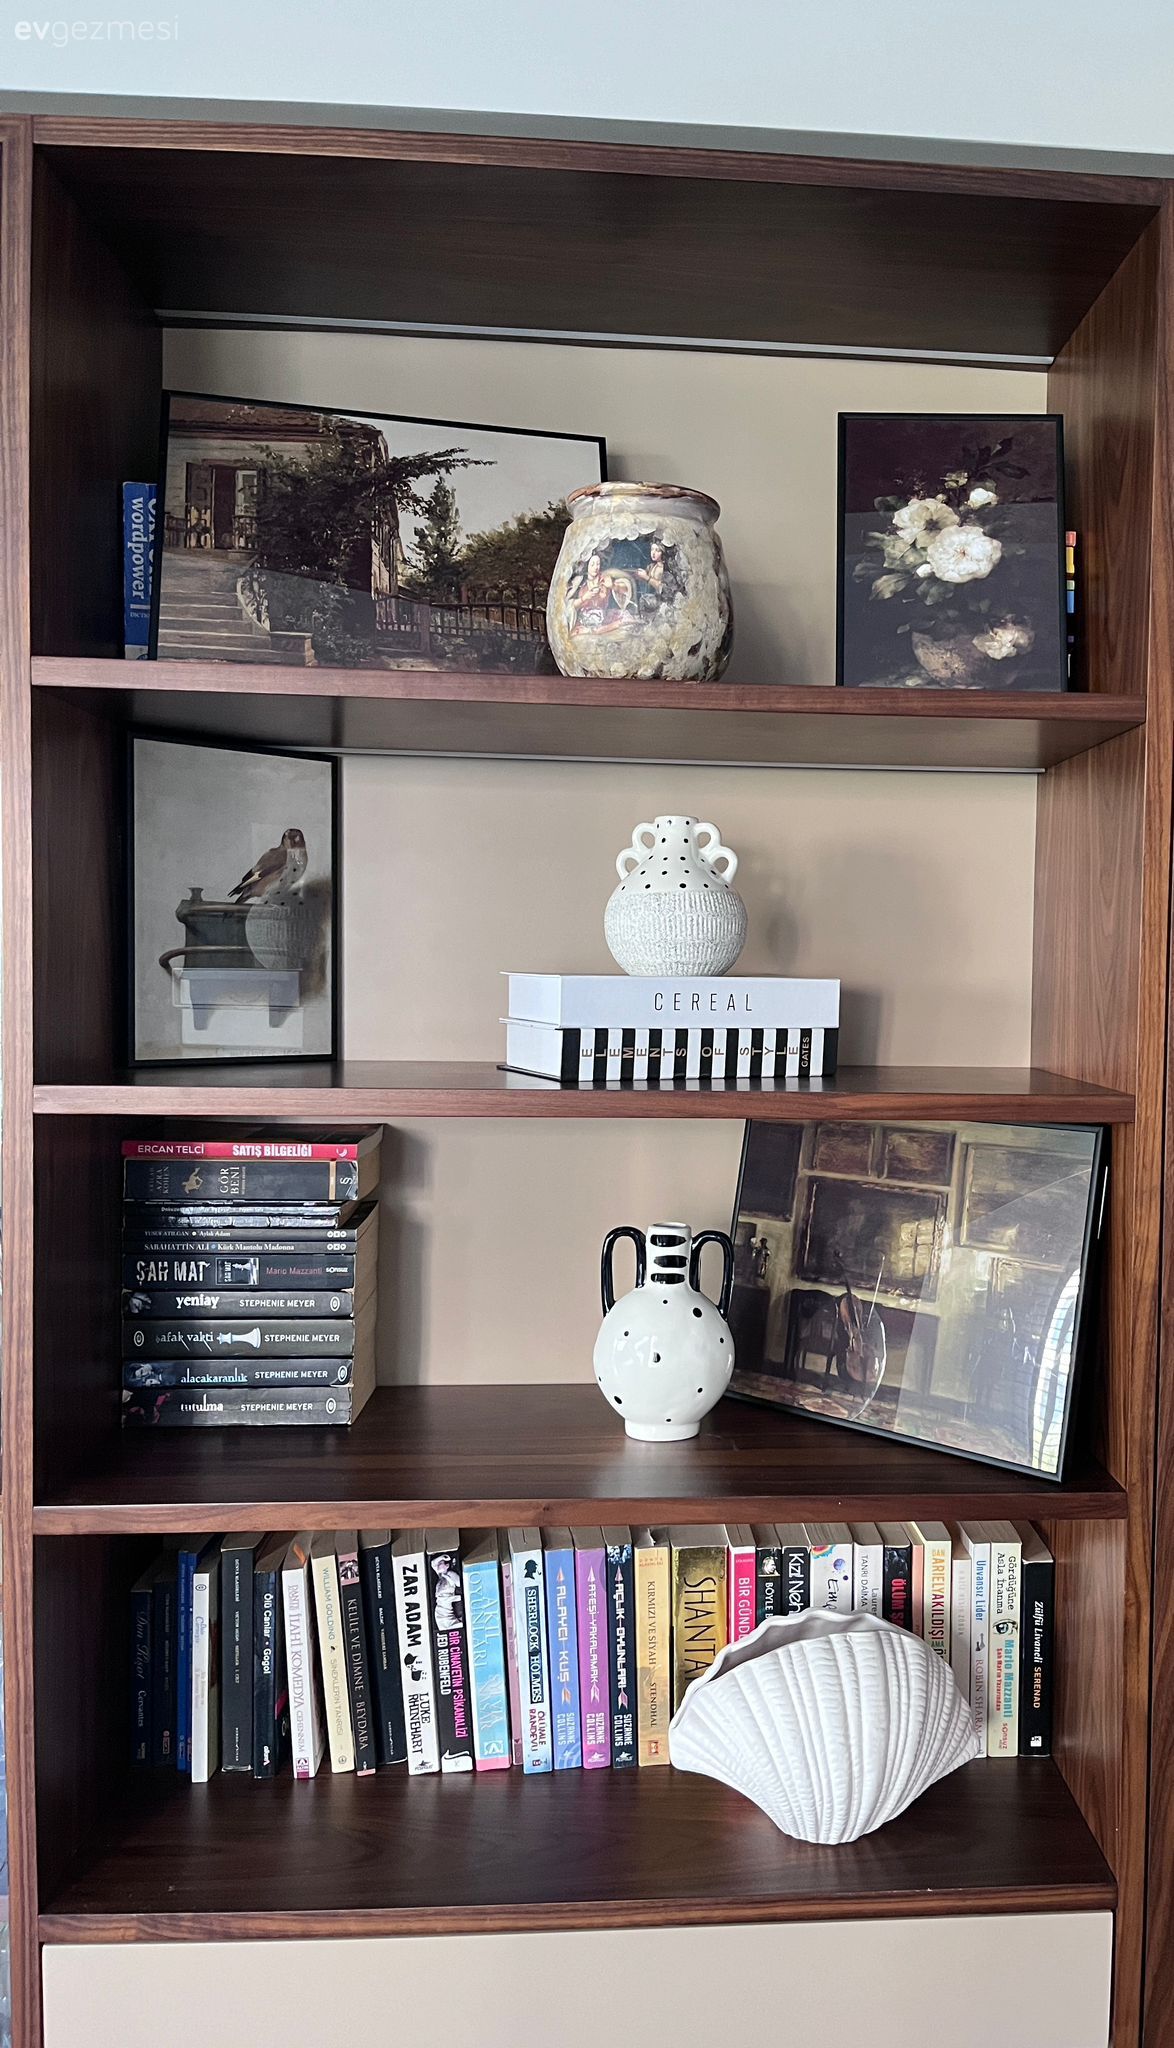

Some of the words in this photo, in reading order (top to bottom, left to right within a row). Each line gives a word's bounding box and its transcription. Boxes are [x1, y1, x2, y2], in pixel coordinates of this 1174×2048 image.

[127, 497, 147, 600] wordpower
[654, 992, 752, 1012] CEREAL
[581, 1047, 687, 1059] ELEMENTS
[702, 1046, 726, 1059] OF
[740, 1046, 799, 1057] STYLE
[801, 1036, 810, 1068] GATES
[137, 1144, 174, 1154] ERCAN
[176, 1143, 204, 1154] TELCİ
[232, 1144, 262, 1158] SATIŞ
[264, 1143, 313, 1157] BİLGELİĞİ
[218, 1167, 229, 1194] GÖR
[229, 1166, 240, 1194] BENİ
[196, 1243, 209, 1251] ALİ
[264, 1243, 295, 1251] Madonna
[136, 1261, 169, 1285] ŞAH
[174, 1260, 211, 1282] MAT
[266, 1267, 287, 1275] Mario
[289, 1267, 323, 1275] Mazzanti
[176, 1293, 220, 1309] yeniay
[239, 1299, 285, 1307] STEPHENIE
[286, 1299, 316, 1308] MEYER
[186, 1331, 214, 1352] vakti
[264, 1334, 310, 1342] STEPHENIE
[311, 1334, 340, 1342] MEYER
[180, 1367, 248, 1383] alacakaranlık
[254, 1371, 299, 1379] STEPHENIE
[300, 1370, 328, 1378] MEYER
[240, 1403, 285, 1411] STEPHENIE
[286, 1403, 313, 1411] MEYER
[402, 1563, 420, 1597] ZAR
[861, 1554, 869, 1577] TANRI
[932, 1558, 945, 1595] ARIELY
[975, 1560, 987, 1597] Unvansız
[996, 1552, 1005, 1575] Asla
[322, 1567, 333, 1603] WILLIAM
[738, 1577, 752, 1597] BİR
[764, 1582, 776, 1610] BÖYLE
[788, 1580, 804, 1615] Neh
[822, 1579, 840, 1610] Emp
[860, 1579, 869, 1607] DAİMA
[891, 1578, 907, 1610] ÖLÜM
[996, 1578, 1006, 1615] İnanma
[1006, 1555, 1018, 1610] Gördüğüne
[263, 1593, 274, 1608] Ölü
[347, 1598, 362, 1633] KELİLE
[557, 1585, 568, 1641] ALAYCI
[613, 1583, 624, 1620] AÇLIK
[647, 1580, 656, 1620] KIRMIZI
[975, 1599, 986, 1622] Lider
[1033, 1600, 1044, 1626] Zülfü
[263, 1610, 272, 1638] Canlar
[288, 1613, 304, 1647] İLAHİ
[325, 1604, 336, 1641] GOLDING
[405, 1601, 422, 1648] ADAM
[469, 1570, 488, 1668] OYUNLARI
[483, 1596, 501, 1642] AKIL
[527, 1588, 540, 1652] SHERLOCK
[648, 1620, 656, 1634] VE
[928, 1594, 944, 1640] AKILDIŞI
[350, 1634, 361, 1651] VE
[436, 1631, 448, 1648] JED
[448, 1630, 461, 1646] BİR
[590, 1619, 599, 1683] YAKALAMAK
[648, 1634, 658, 1665] SİYAH
[1003, 1639, 1015, 1670] Mario
[1034, 1627, 1043, 1664] Livaneli
[261, 1648, 272, 1674] Gogol
[351, 1653, 366, 1691] DİMNE
[437, 1648, 452, 1696] RUBENFELD
[450, 1646, 465, 1687] CİNAYETİN
[557, 1650, 570, 1682] KUŞ
[616, 1627, 627, 1689] OYUNLARI
[290, 1650, 305, 1709] KOMEDYA
[530, 1655, 543, 1703] HOLMES
[974, 1659, 984, 1692] ROBIN
[1033, 1666, 1042, 1709] SERENAD
[137, 1690, 147, 1727] Cervantes
[419, 1692, 431, 1724] LUKE
[650, 1682, 658, 1728] STENDHAL
[1003, 1672, 1014, 1718] Mazzanti
[334, 1705, 344, 1736] TANRISI
[355, 1701, 368, 1751] BEYDABA
[408, 1693, 423, 1755] RHINEHART
[452, 1689, 469, 1739] PSİKANALİZİ
[528, 1708, 539, 1752] RANDEVU
[557, 1713, 567, 1746] COLLINS
[566, 1712, 576, 1745] SUZANNE
[586, 1713, 597, 1745] COLLINS
[595, 1712, 606, 1745] SUZANNE
[613, 1714, 624, 1747] COLLINS
[623, 1713, 633, 1746] SUZANNE
[296, 1710, 305, 1753] CEHENNEM
